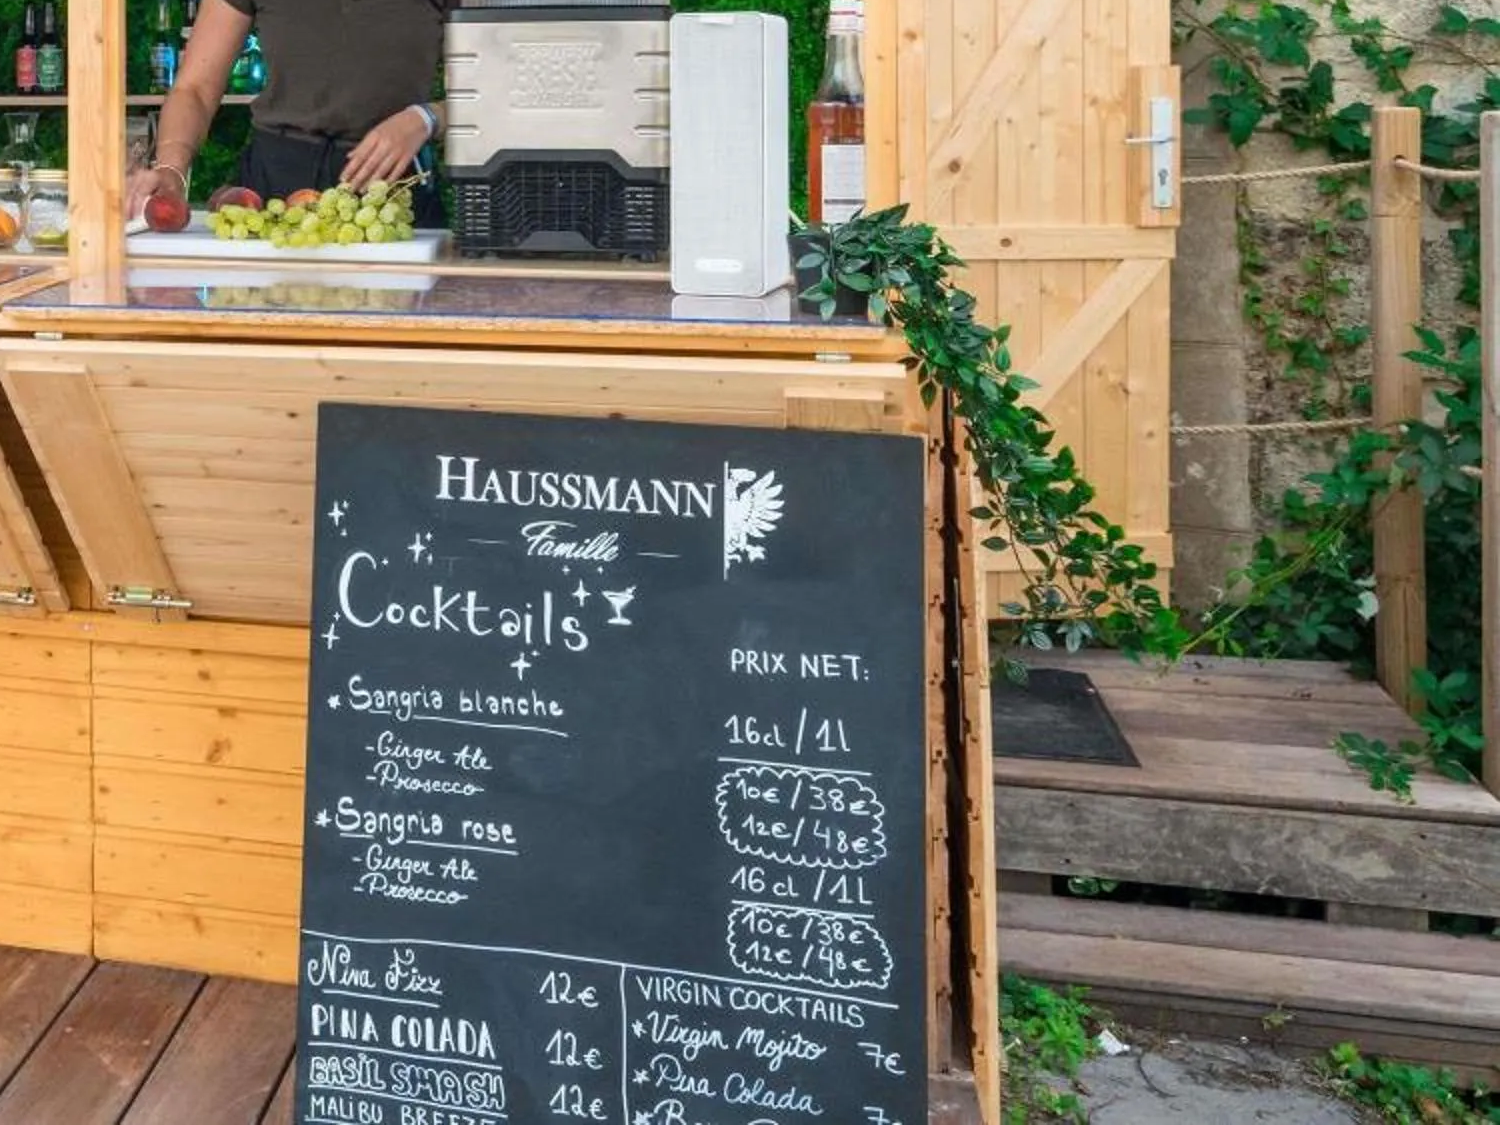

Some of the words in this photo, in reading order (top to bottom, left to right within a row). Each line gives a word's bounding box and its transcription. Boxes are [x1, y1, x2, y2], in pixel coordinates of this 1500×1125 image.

[435, 455, 716, 518] HAUSSMANN
[520, 520, 621, 562] Famille
[338, 551, 591, 652] Cocktails
[730, 648, 788, 676] PRIX
[800, 653, 870, 681] NET:
[348, 675, 443, 721] Sangria
[458, 689, 565, 716] blanche
[453, 744, 493, 770] Ale
[335, 796, 443, 845] Sangria
[462, 819, 517, 844] rose
[440, 858, 478, 881] Ale
[539, 971, 600, 1007] 12€
[636, 975, 722, 1007] VIRGIN
[729, 986, 865, 1028] COCKTAILS
[310, 1004, 379, 1043] PINA
[391, 1014, 497, 1061] COLADA
[545, 1028, 604, 1070] 12€
[647, 1010, 729, 1061] Virgin
[736, 1026, 828, 1072] Mojito
[390, 1062, 506, 1111] SMASH
[549, 1083, 608, 1120] 12€
[723, 1072, 824, 1116] Colada
